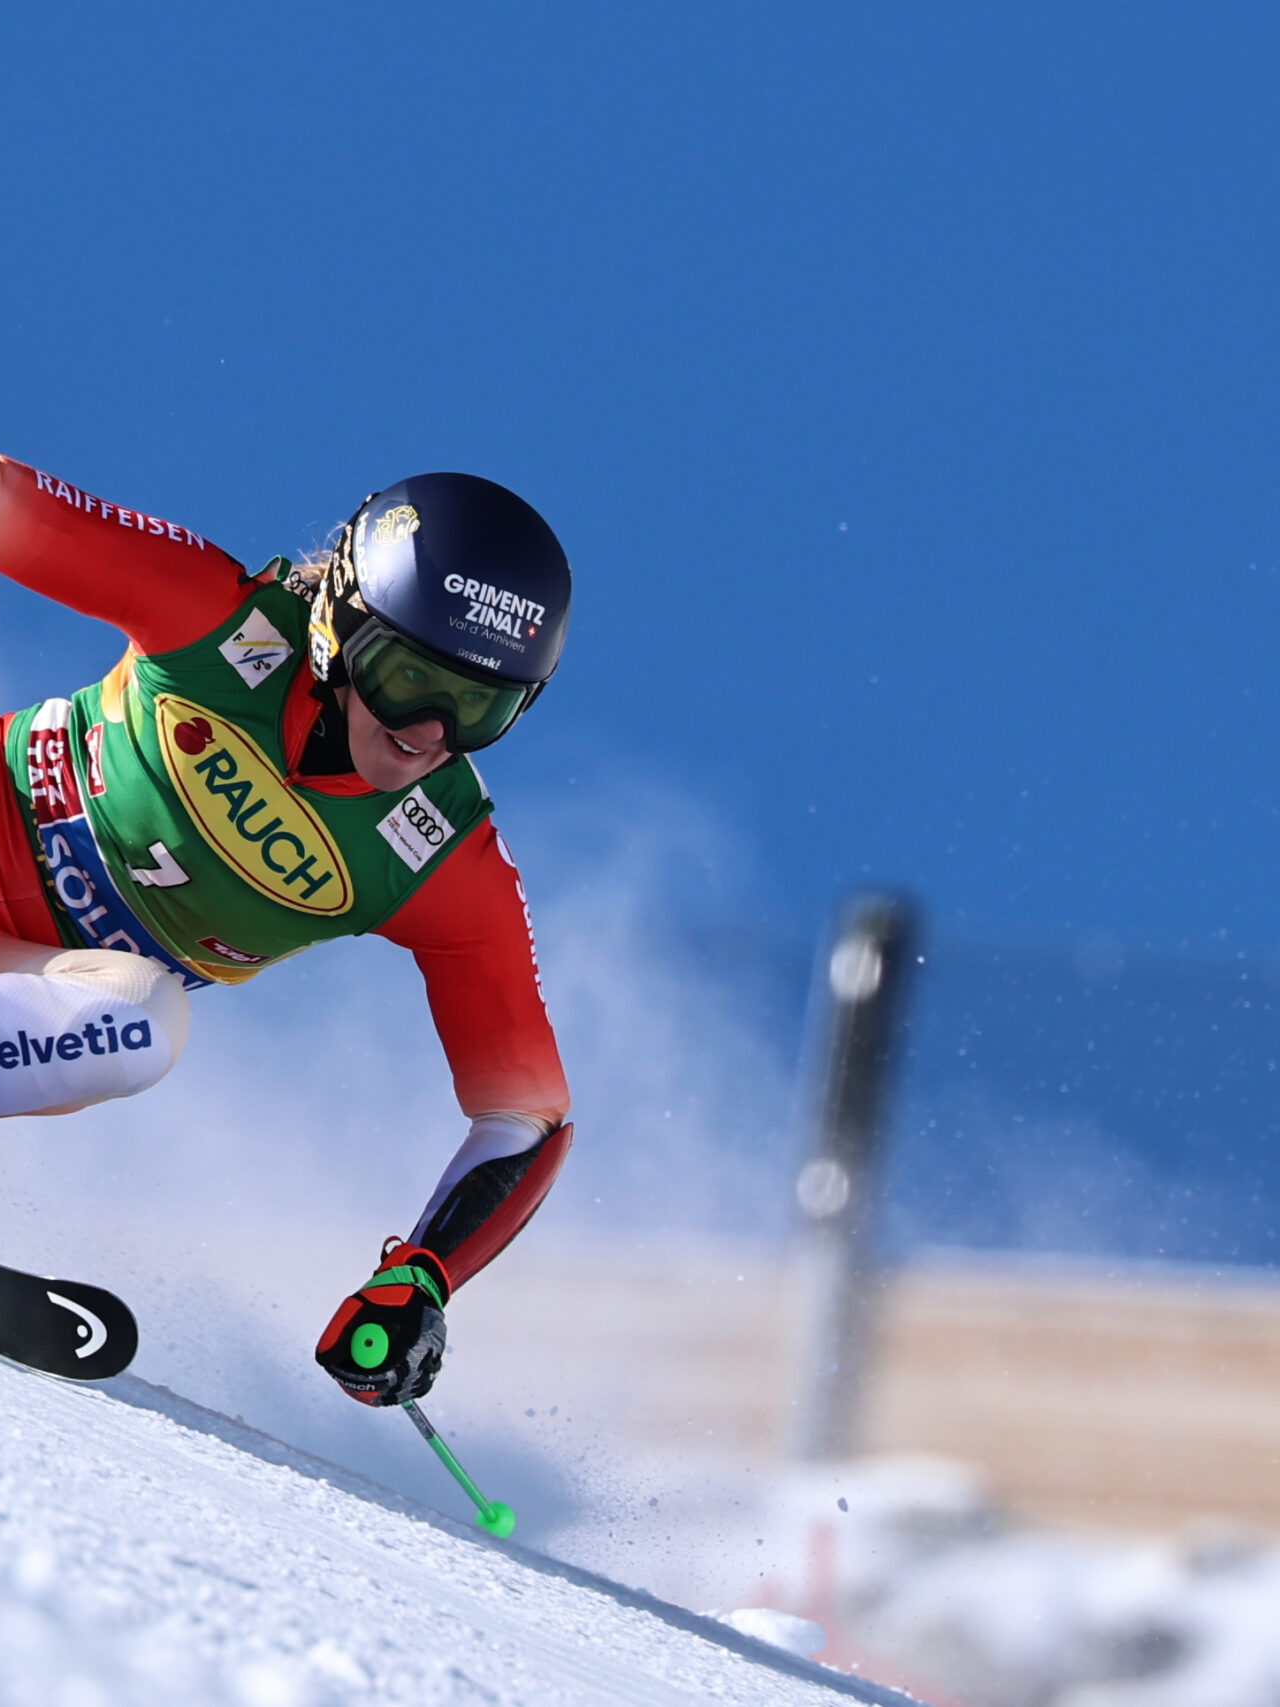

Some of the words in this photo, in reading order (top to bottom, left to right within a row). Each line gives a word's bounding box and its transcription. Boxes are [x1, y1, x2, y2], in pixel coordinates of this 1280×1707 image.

[34, 469, 206, 551] RAIFFEISEN
[443, 573, 546, 626] GRIMENTZ
[448, 616, 469, 632] Val
[464, 601, 523, 640] ZINAL
[194, 747, 334, 901] RAUCH
[46, 832, 205, 992] SÖLD
